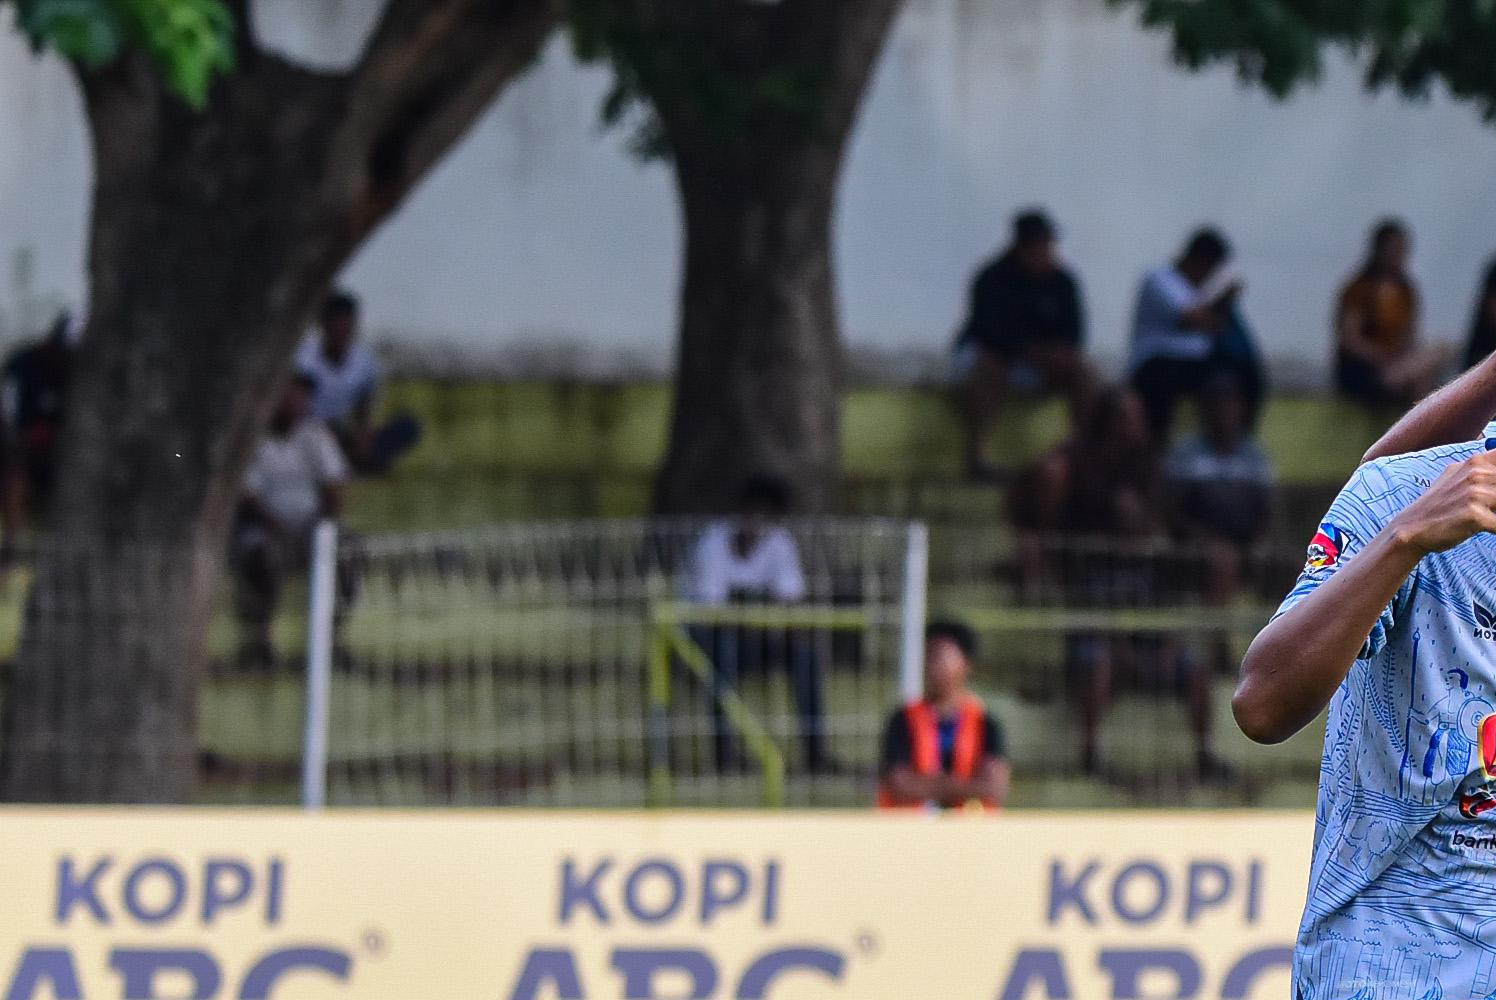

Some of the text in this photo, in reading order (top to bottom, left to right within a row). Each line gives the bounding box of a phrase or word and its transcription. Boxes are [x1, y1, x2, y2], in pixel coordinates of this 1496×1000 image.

[54, 854, 286, 927] KOPI
[558, 854, 783, 927] KOPI
[1045, 854, 1265, 927] KOPI
